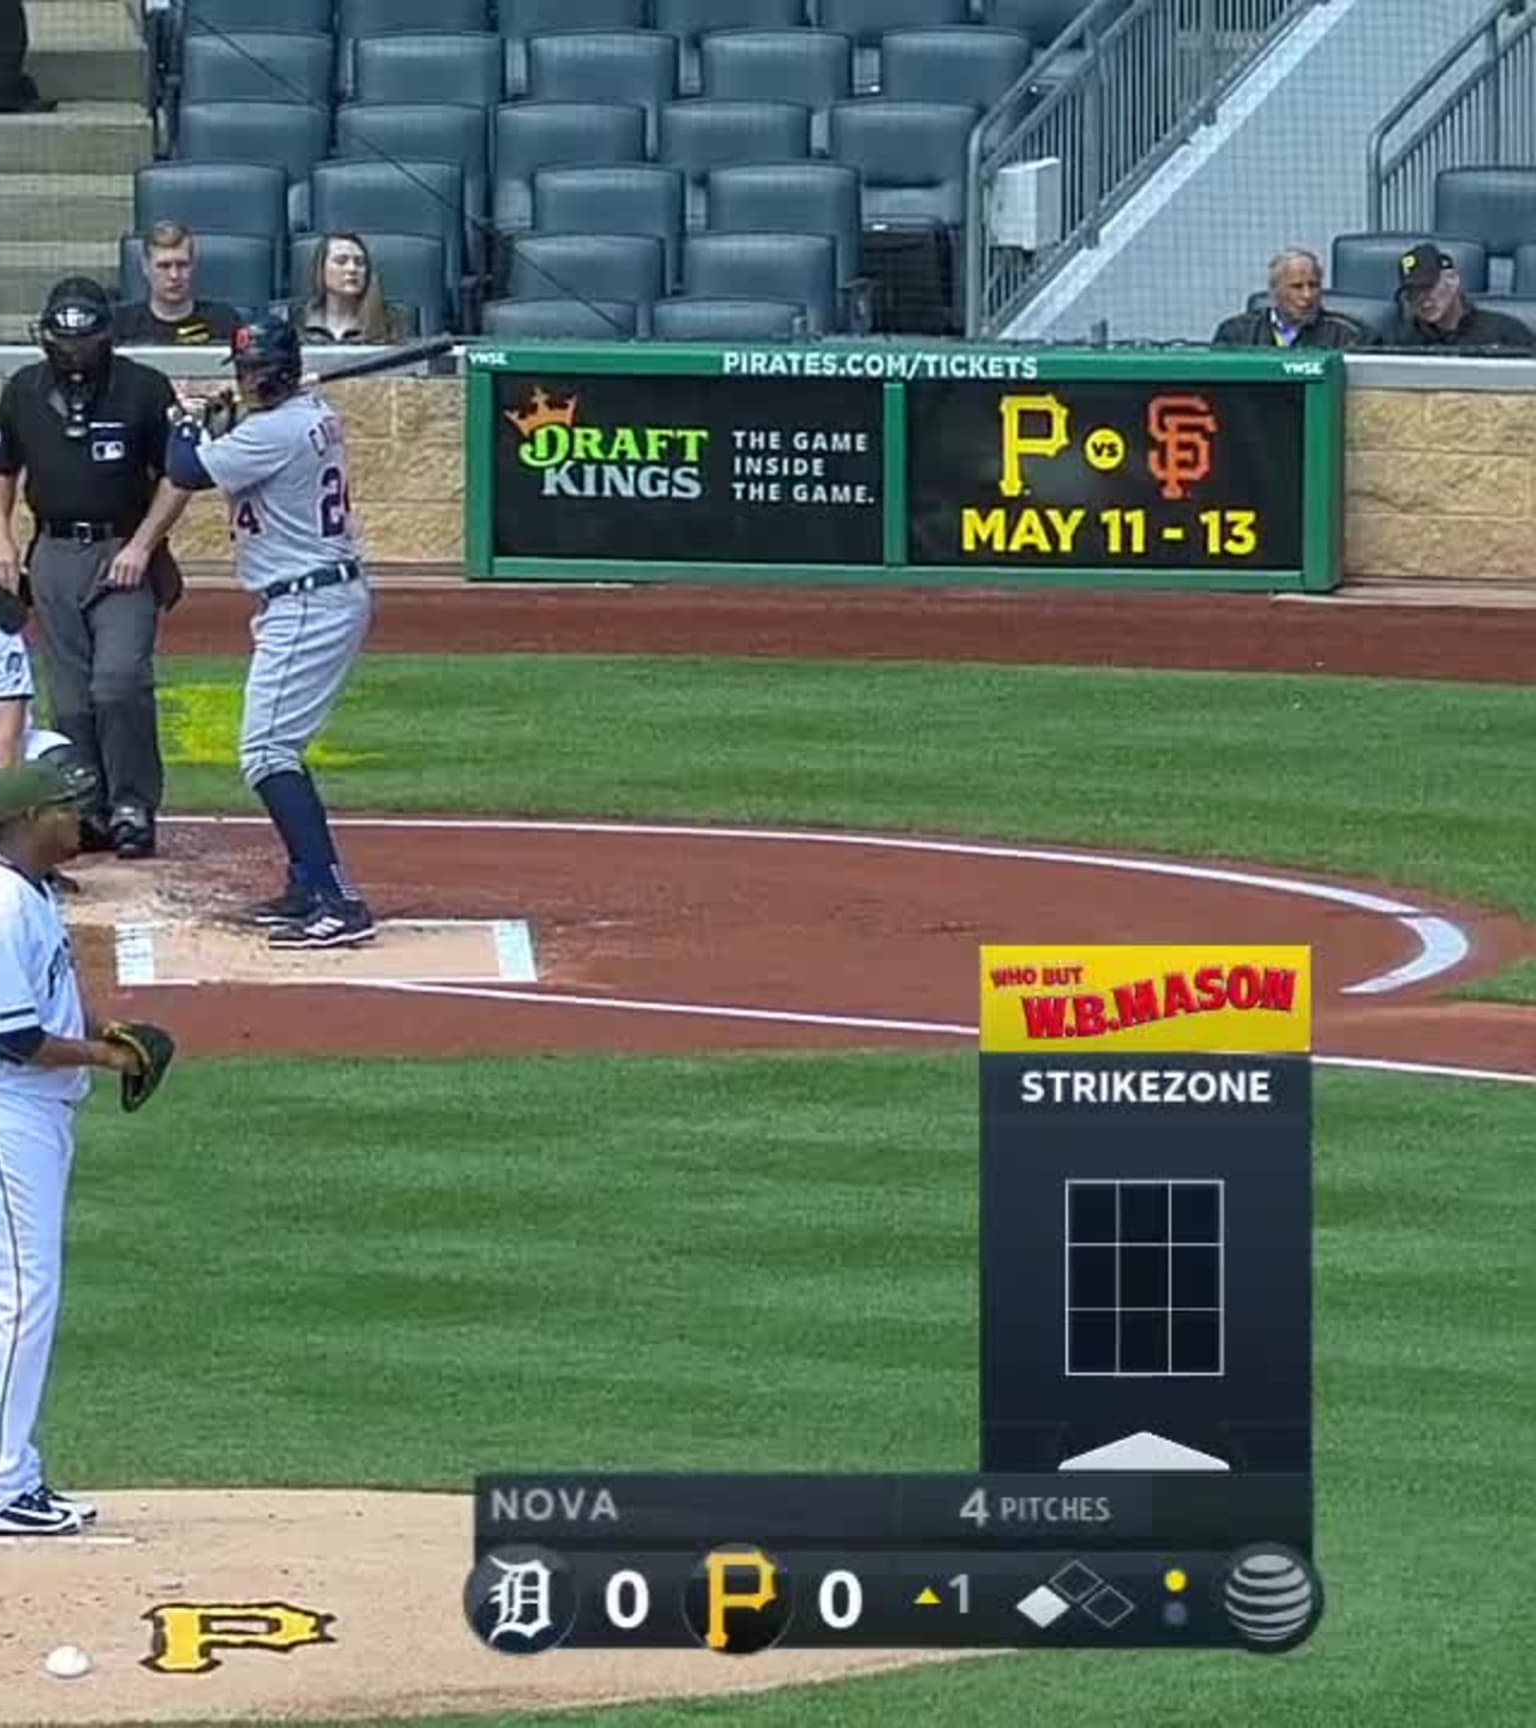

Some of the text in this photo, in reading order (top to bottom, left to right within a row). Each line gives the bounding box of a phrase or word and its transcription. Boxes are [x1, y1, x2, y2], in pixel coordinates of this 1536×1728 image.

[724, 351, 1038, 379] PIRATES.COM/TICKETS
[519, 424, 708, 467] DRAFT
[733, 430, 869, 452] THE GAME
[542, 461, 702, 499] KINGS
[733, 456, 825, 476] INSIDE
[321, 467, 351, 538] 2
[732, 482, 875, 504] THE GAME.
[962, 508, 1086, 553] MAY
[1100, 509, 1146, 553] 11
[1199, 510, 1259, 555] 13
